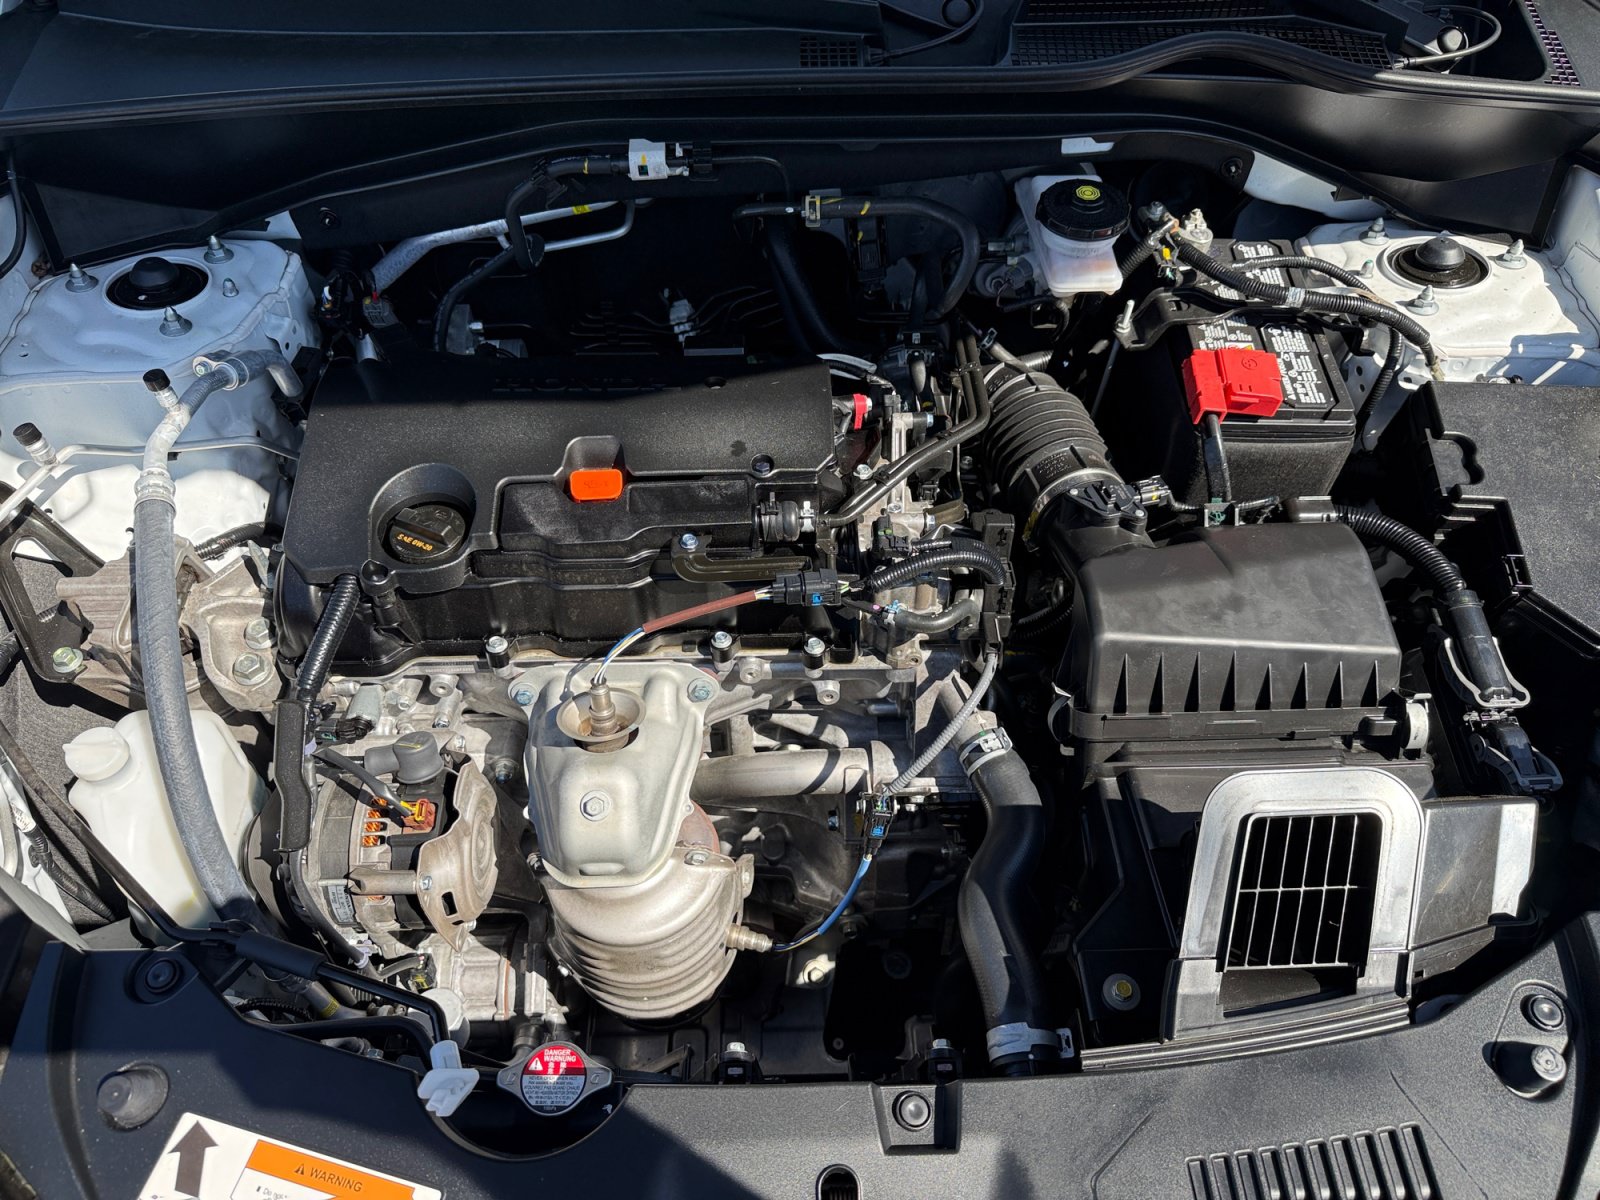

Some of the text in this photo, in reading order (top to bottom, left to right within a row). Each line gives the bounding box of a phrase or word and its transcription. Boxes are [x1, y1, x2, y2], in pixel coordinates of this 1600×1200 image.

[397, 533, 433, 551] SAE 0W-20
[310, 1167, 363, 1192] WARNING
